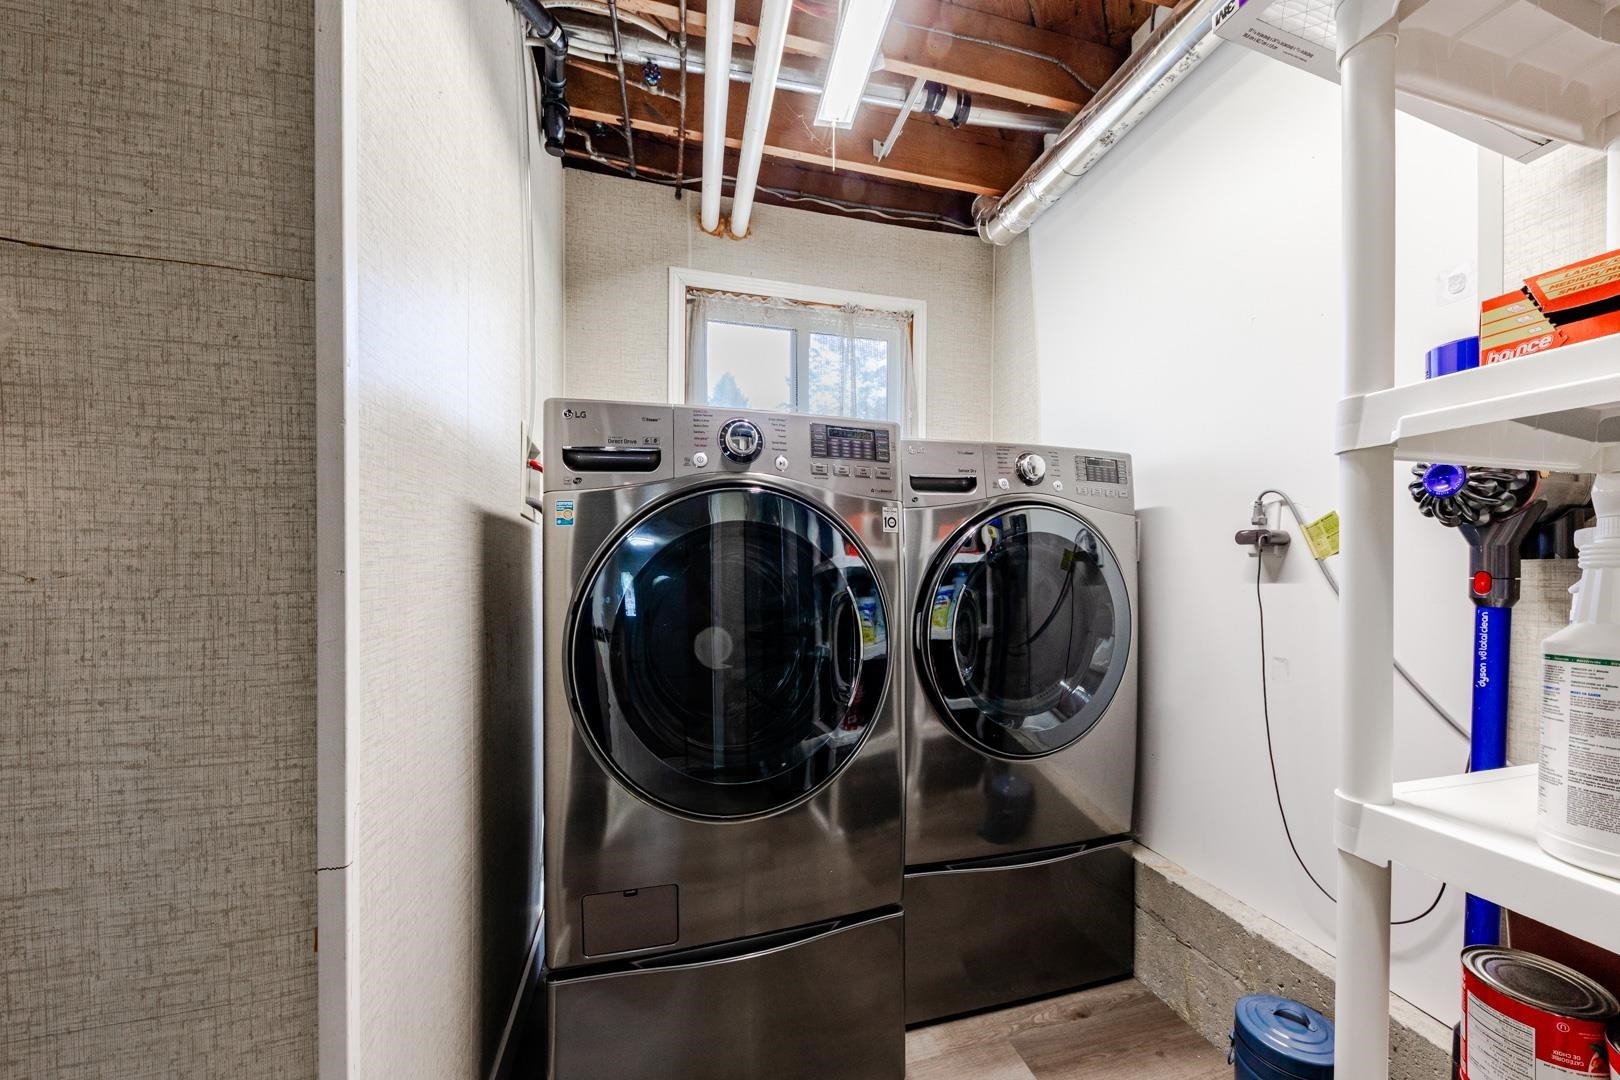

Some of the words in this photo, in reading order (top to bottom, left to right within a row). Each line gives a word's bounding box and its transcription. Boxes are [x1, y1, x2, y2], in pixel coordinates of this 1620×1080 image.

[1486, 333, 1554, 365] bounce
[884, 516, 896, 528] 10
[1479, 611, 1489, 633] clean
[1479, 633, 1488, 651] total
[1479, 651, 1488, 661] v8
[1478, 662, 1490, 688] dyson
